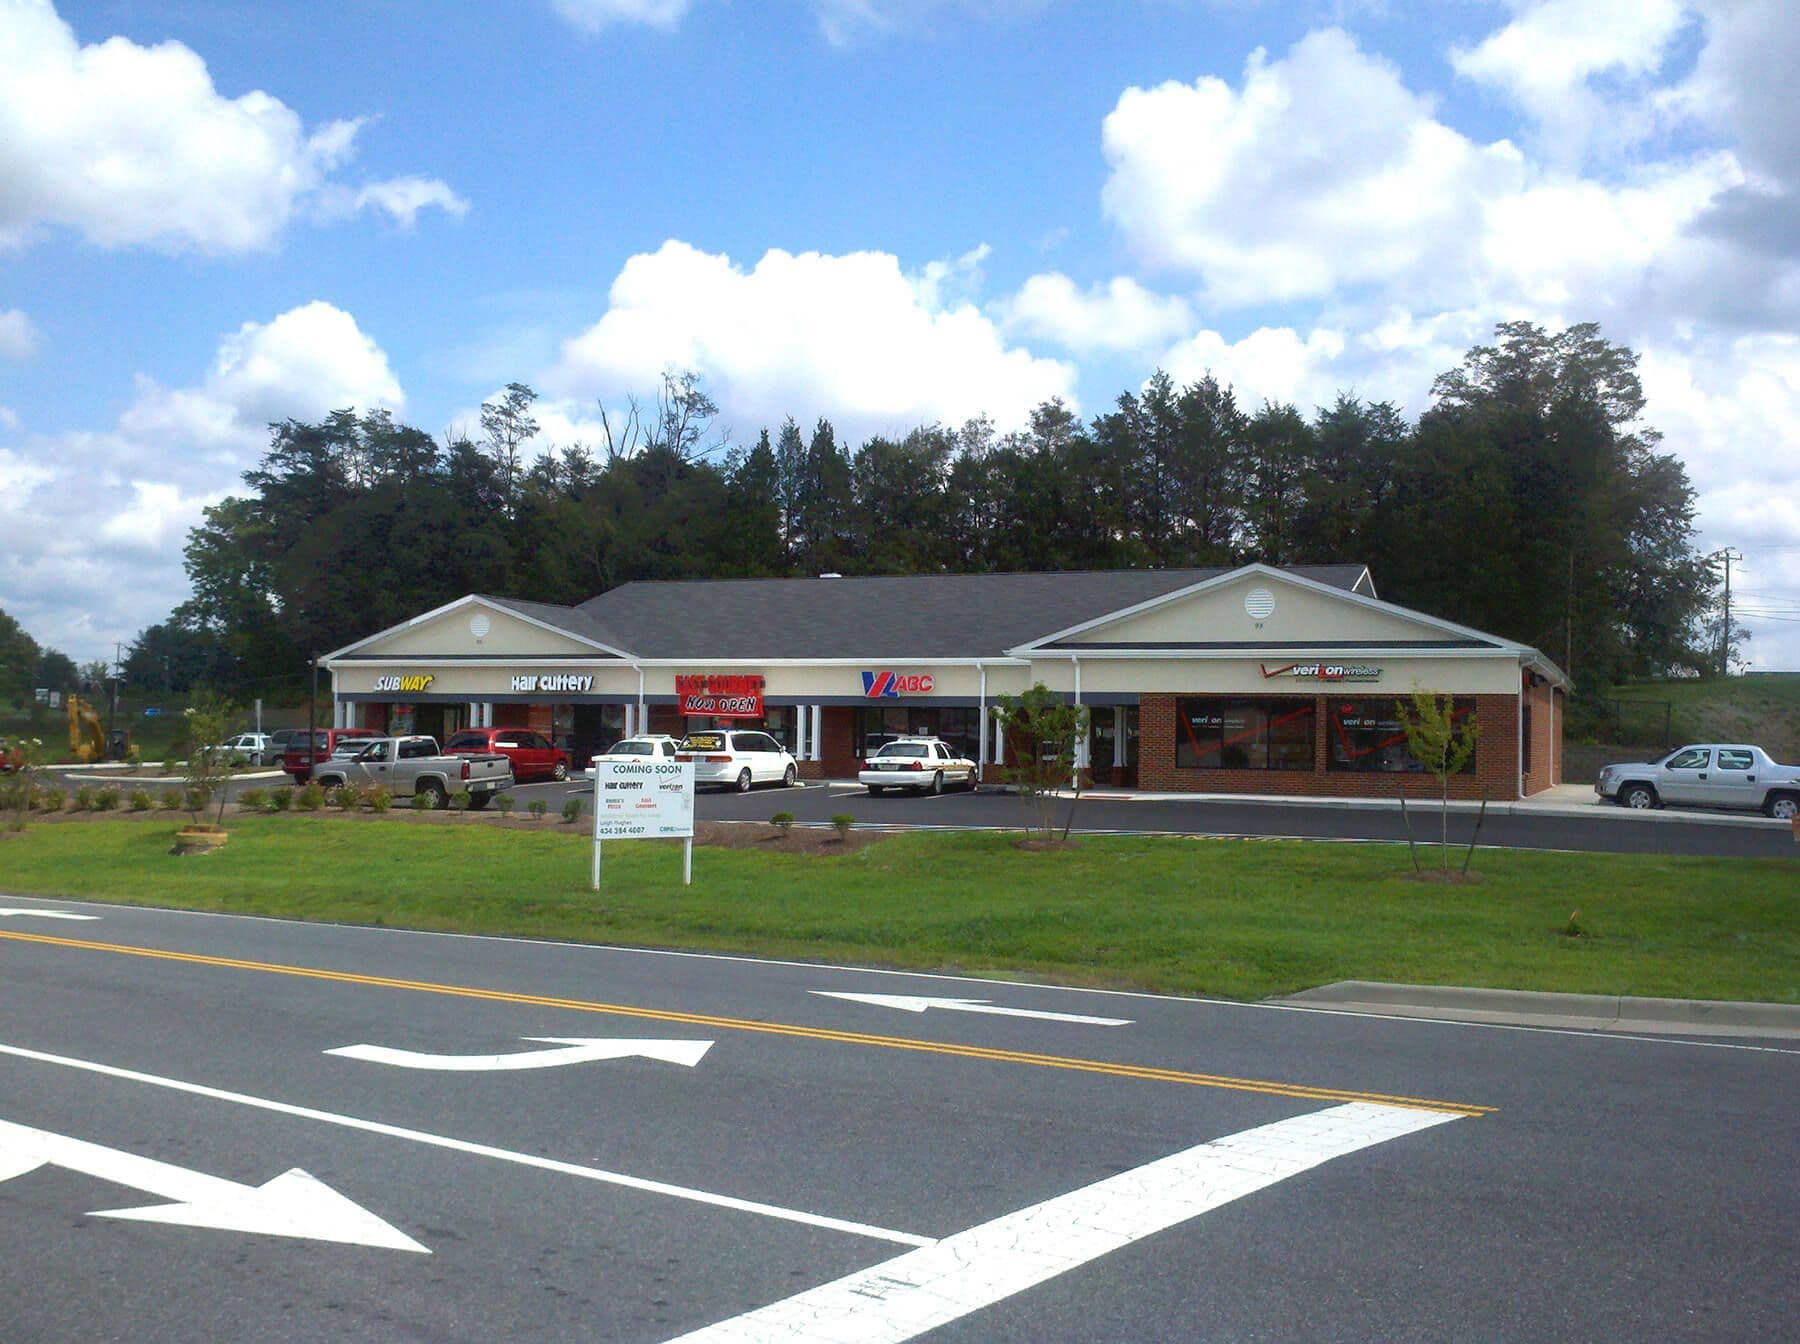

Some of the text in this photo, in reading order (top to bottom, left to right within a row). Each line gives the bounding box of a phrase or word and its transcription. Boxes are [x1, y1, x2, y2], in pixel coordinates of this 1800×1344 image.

[1293, 664, 1379, 678] verizon wireless
[375, 675, 434, 691] SUBWAY
[891, 675, 934, 692] ABC
[686, 695, 757, 712] NOW OPEN
[1191, 715, 1222, 724] verion
[1343, 717, 1376, 726] verion
[613, 765, 682, 774] COMING SOON
